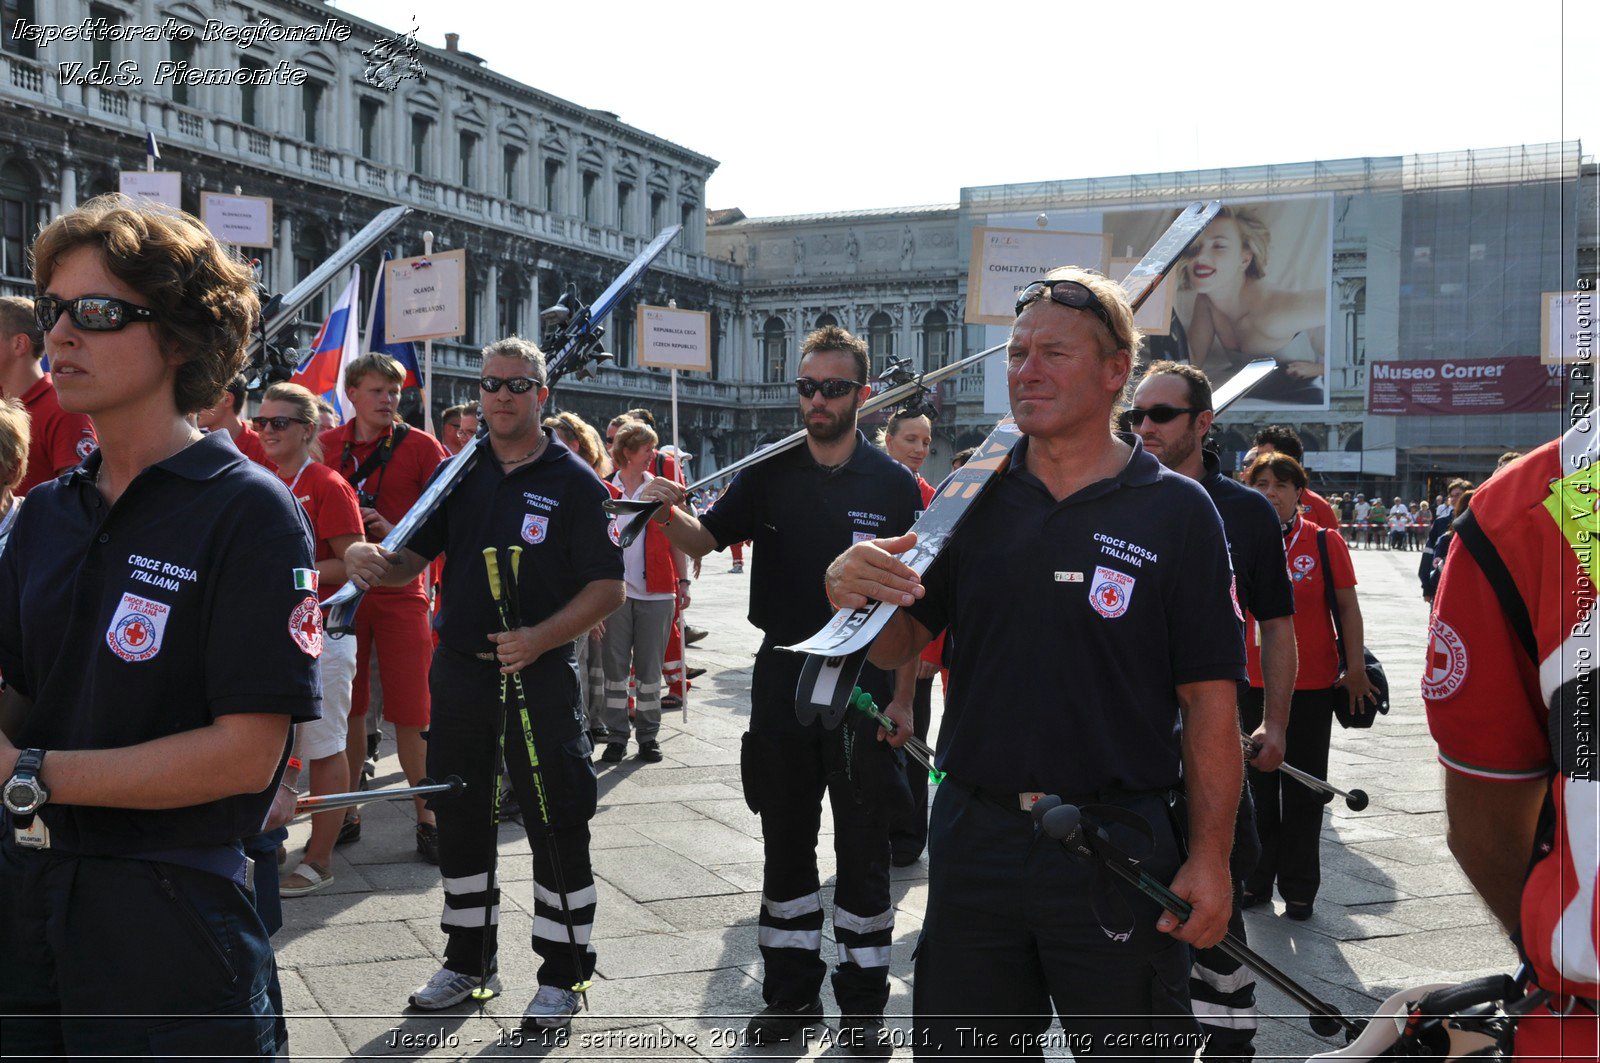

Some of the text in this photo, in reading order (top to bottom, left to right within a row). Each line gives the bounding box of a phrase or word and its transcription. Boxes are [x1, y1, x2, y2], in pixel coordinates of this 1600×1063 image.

[989, 264, 1037, 274] COMITATO
[413, 286, 435, 295] OLANDA
[403, 305, 446, 317] (NETHERLANDS)
[653, 327, 683, 335] REPUBBLICA
[672, 343, 698, 351] REPUBLIC)
[1373, 363, 1505, 379] Museo Correr
[523, 491, 542, 502] CROCE
[526, 499, 552, 512] ITALIANA
[847, 511, 887, 522] CROCE ROSSA
[853, 518, 880, 528] ITALIANA
[1093, 532, 1158, 563] CROCE ROSSA
[1100, 545, 1142, 568] ITALIANA
[127, 554, 197, 582] CROCE ROSSA
[130, 569, 180, 592] ITALIANA
[1097, 568, 1133, 584] CROCE ROSSA
[1102, 574, 1126, 586] ITALIANA
[123, 595, 168, 614] CROCE ROSSA
[127, 603, 157, 617] ITALIANA
[291, 607, 304, 629] CROCE
[834, 601, 879, 638] TRA
[1444, 631, 1458, 645] 22
[108, 631, 135, 660] SOCCORSO
[140, 646, 158, 660] PISTE
[1447, 646, 1465, 689] AGOSTO
